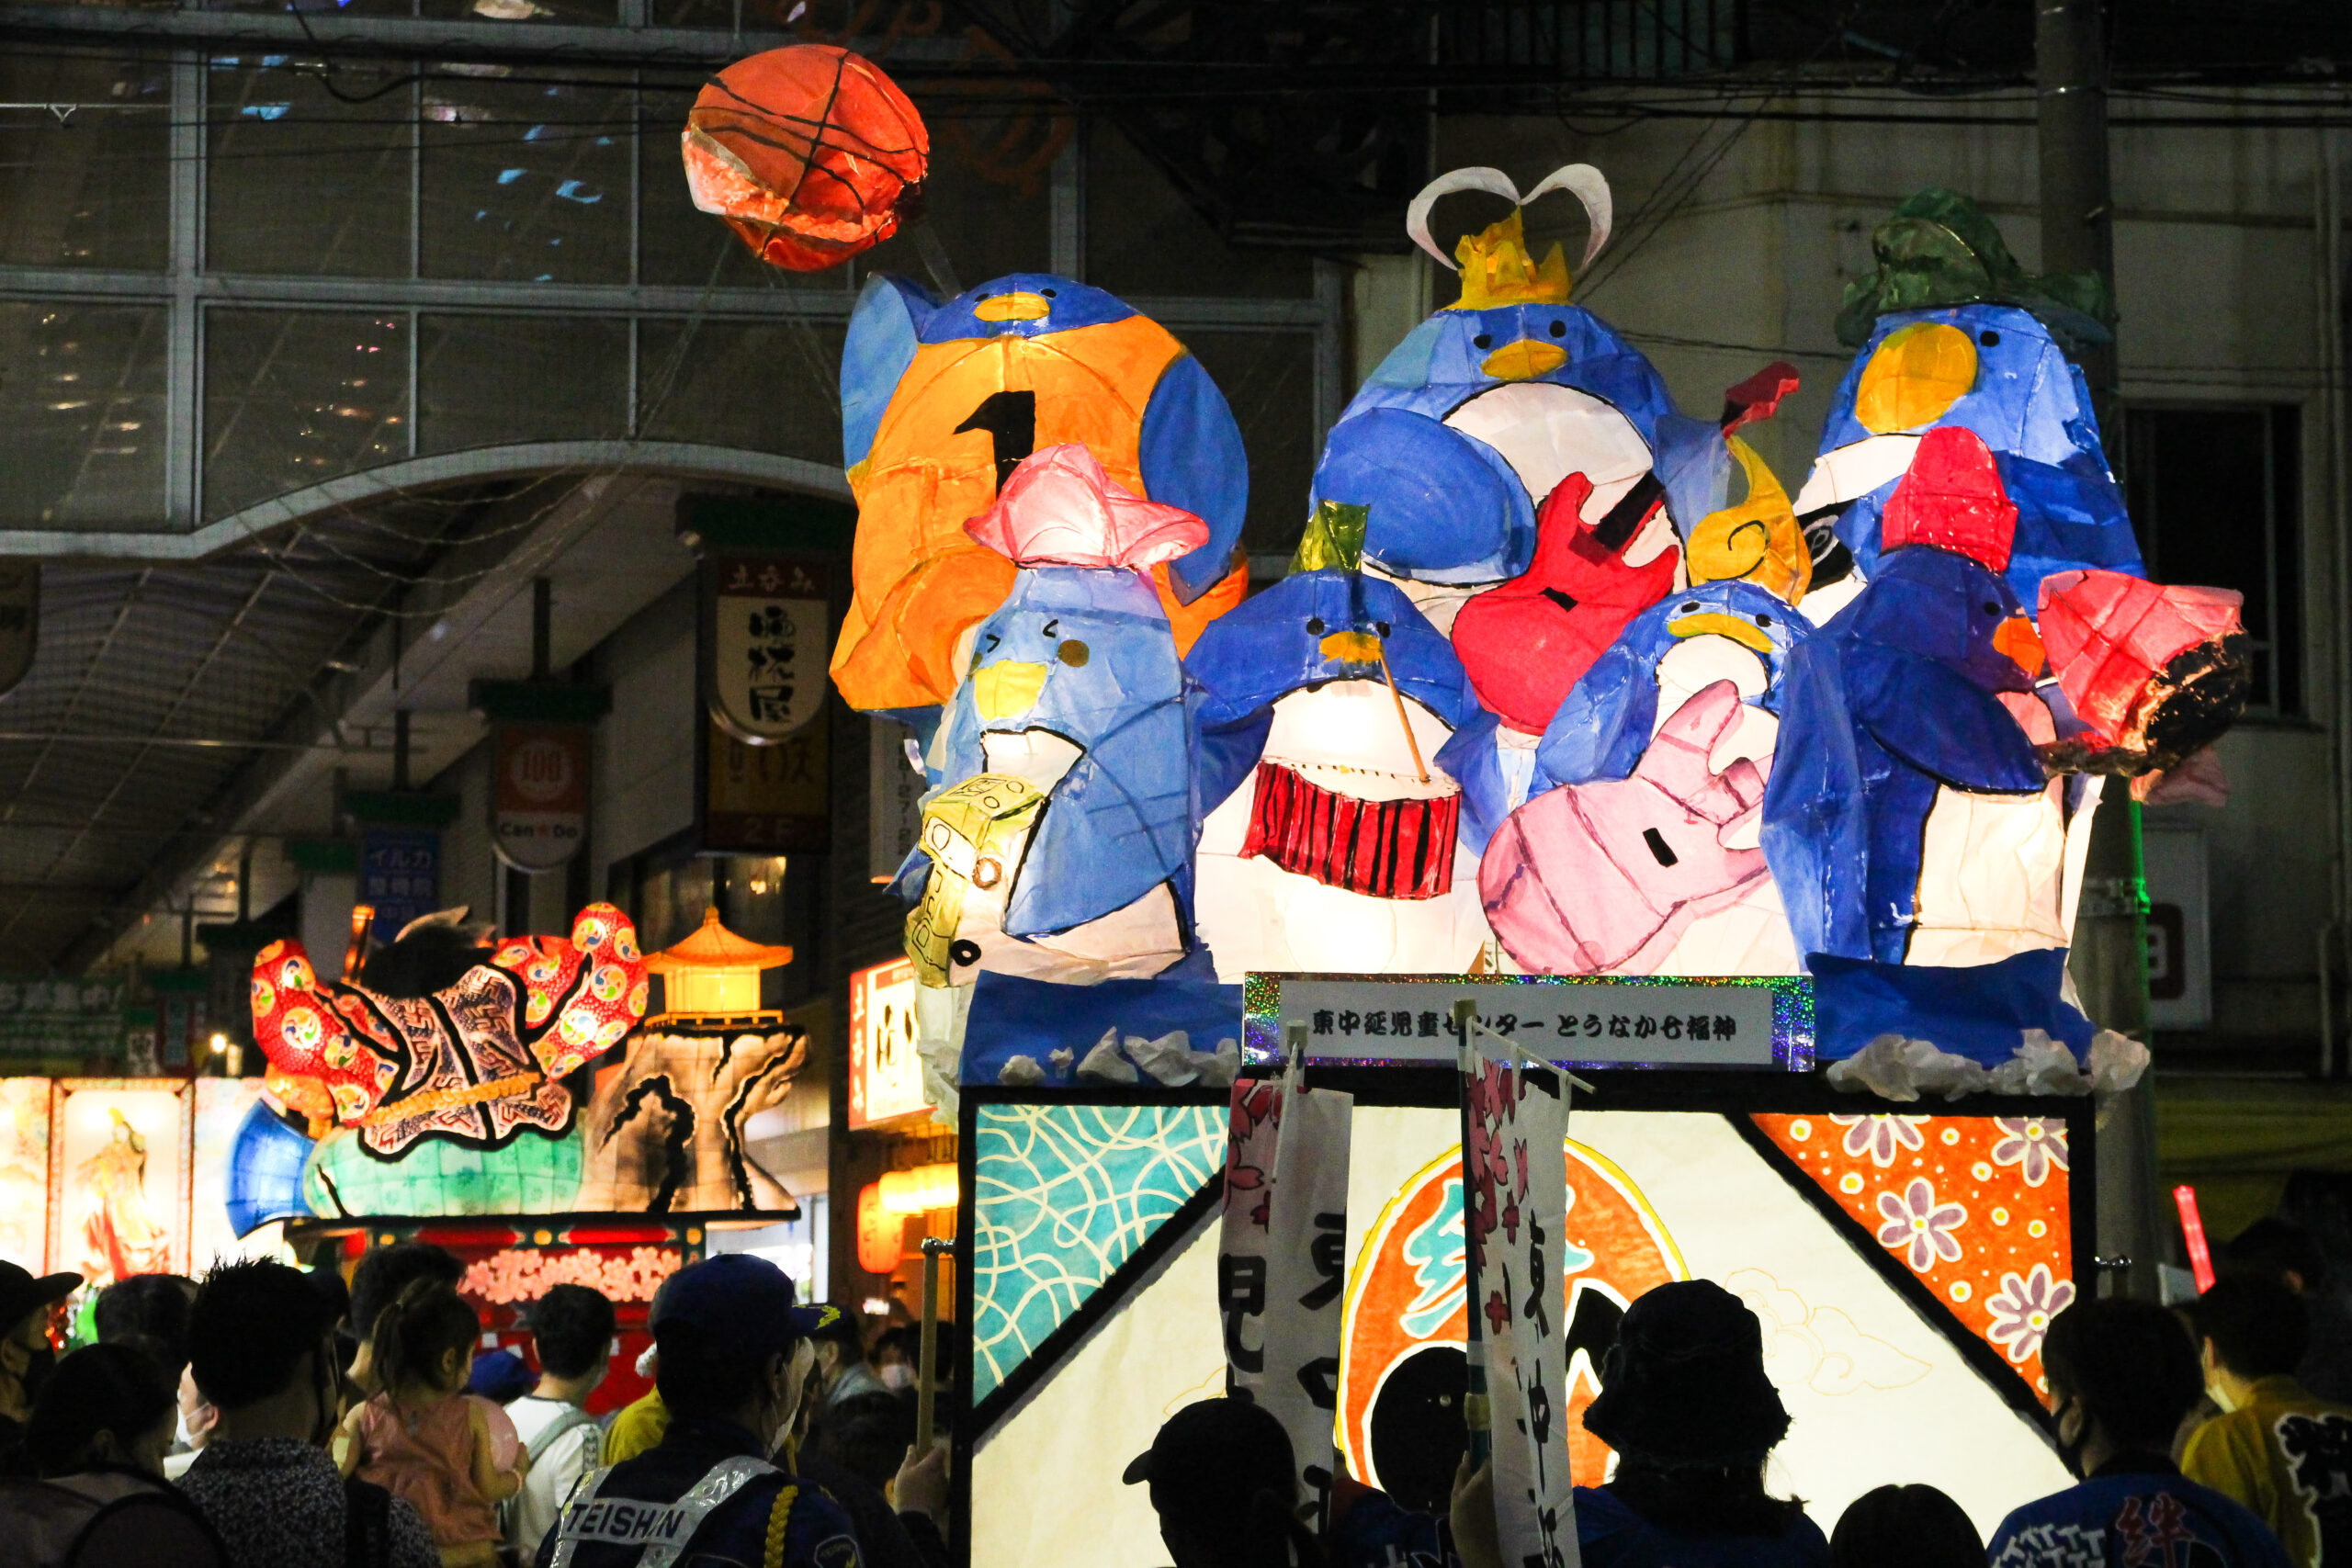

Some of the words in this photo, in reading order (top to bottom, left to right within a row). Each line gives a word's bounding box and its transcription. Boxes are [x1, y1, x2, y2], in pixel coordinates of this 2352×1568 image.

[522, 749, 561, 784] 100
[499, 821, 535, 837] Can
[552, 823, 578, 839] Do
[1557, 1013, 1737, 1041] とうなか七福神
[567, 1503, 686, 1540] TEISHIN
